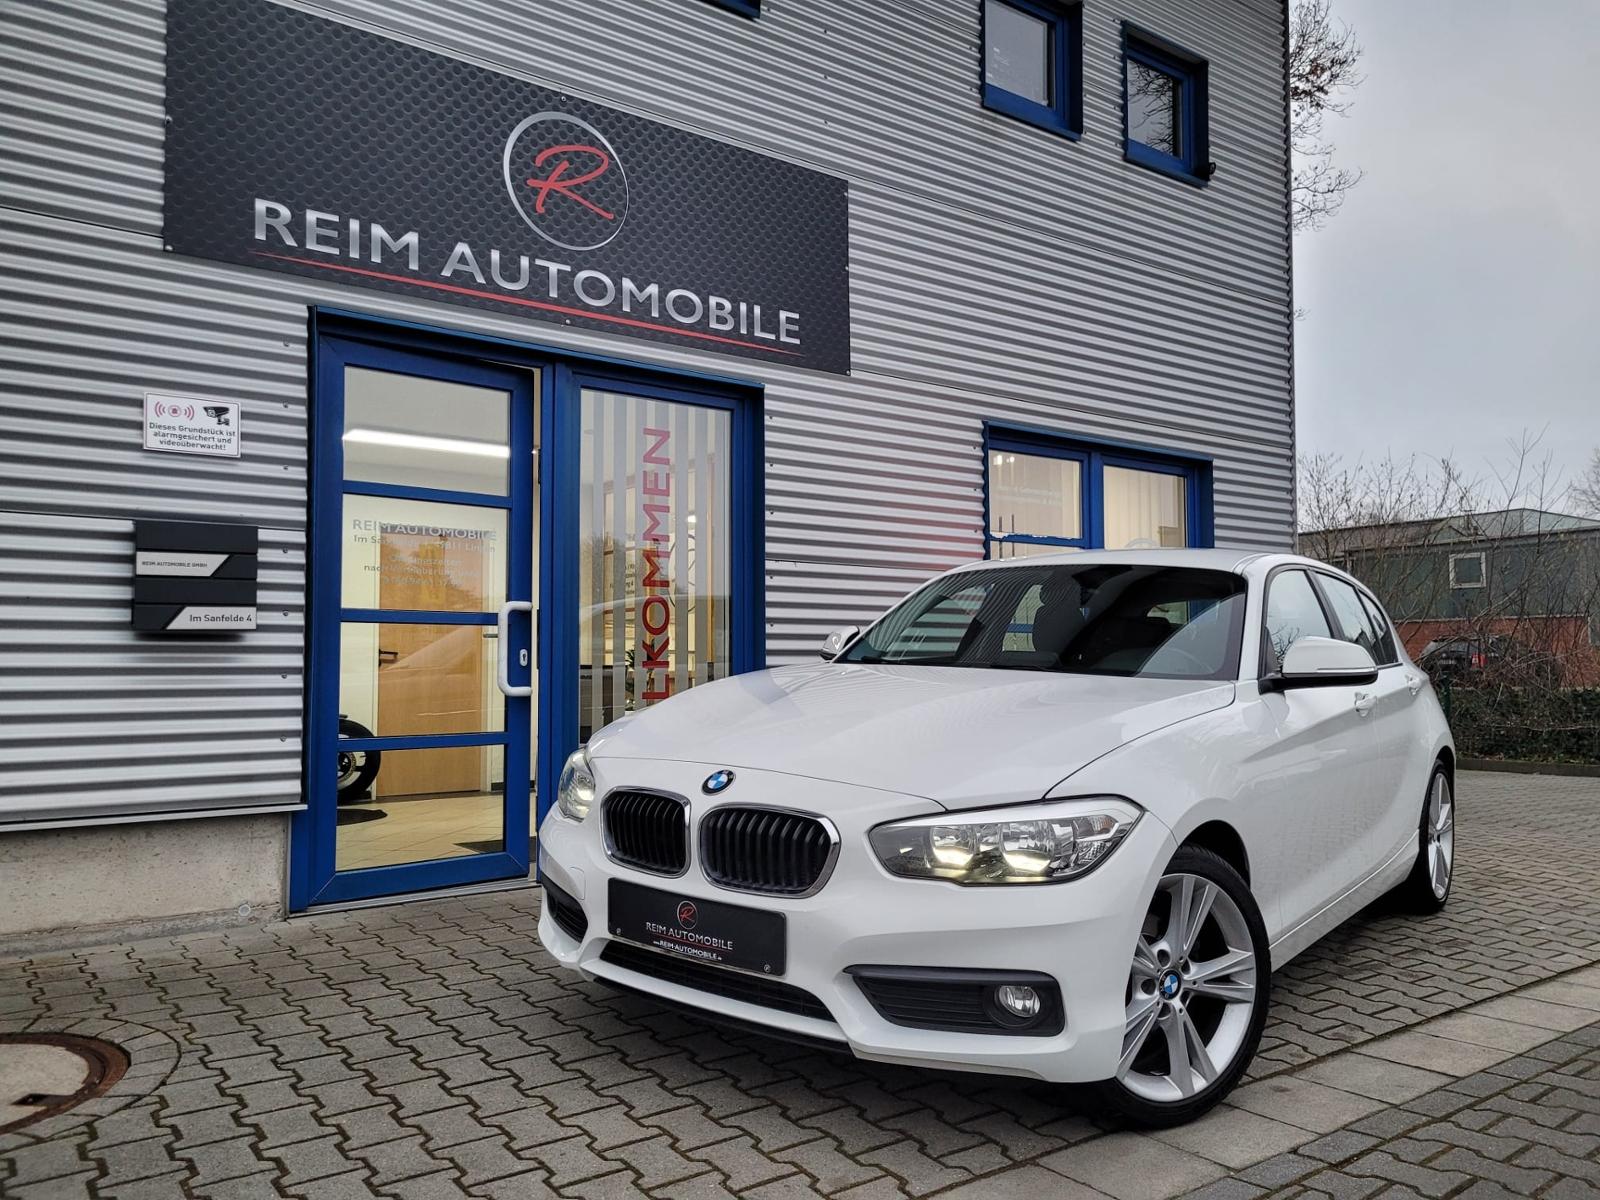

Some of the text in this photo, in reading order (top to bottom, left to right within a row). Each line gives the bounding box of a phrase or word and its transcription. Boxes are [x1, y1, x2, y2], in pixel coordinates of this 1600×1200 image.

[253, 197, 801, 345] REIM AUTOMOBILE
[149, 422, 236, 437] Dieses Grundstück ist
[153, 431, 215, 443] alarmgesichert
[160, 440, 227, 450] videoüberwacht!
[190, 614, 252, 622] Im Sanfelde 4
[646, 922, 734, 950] REIM AUTOMOBILE
